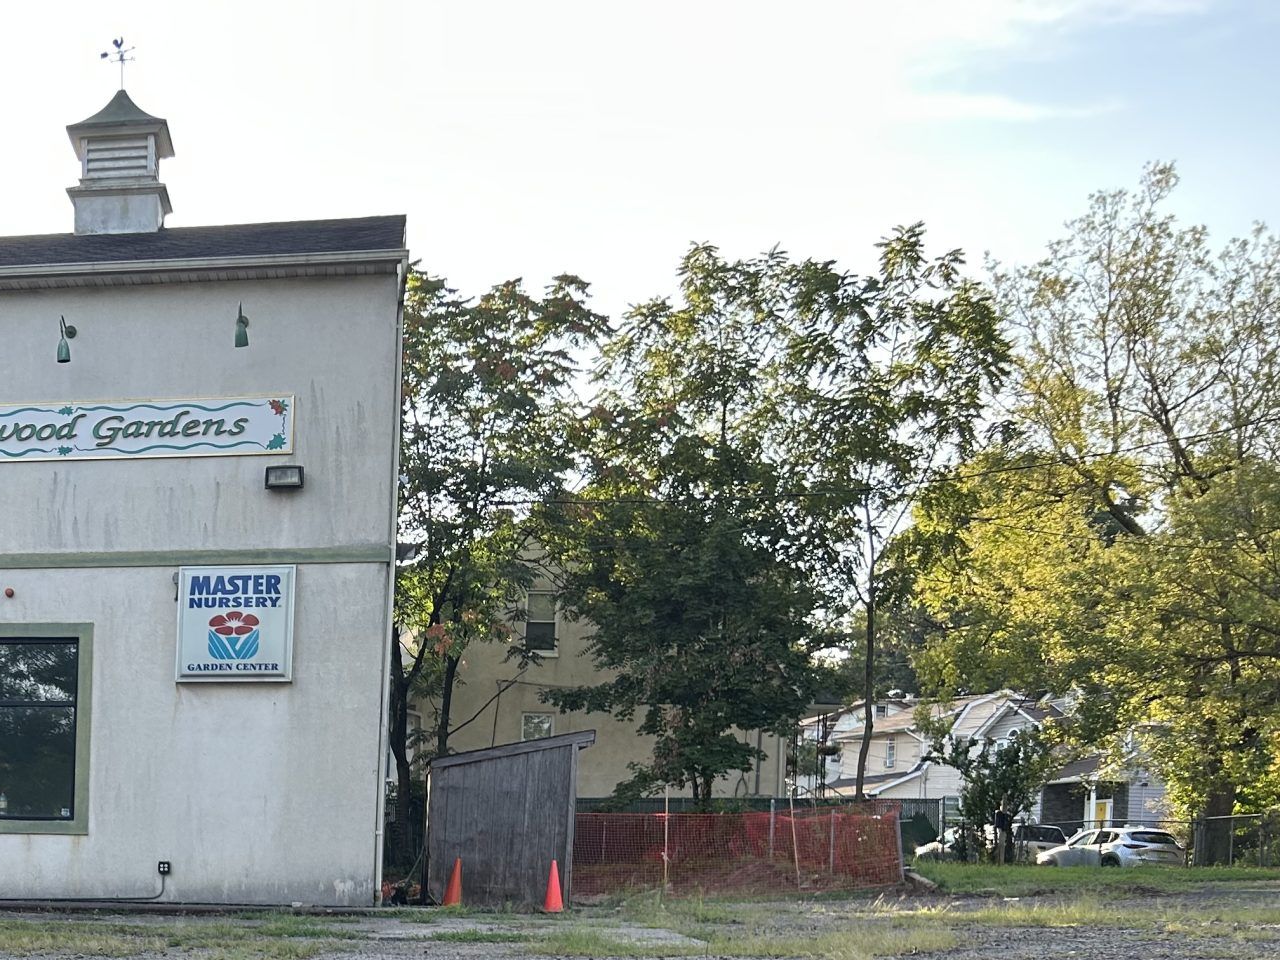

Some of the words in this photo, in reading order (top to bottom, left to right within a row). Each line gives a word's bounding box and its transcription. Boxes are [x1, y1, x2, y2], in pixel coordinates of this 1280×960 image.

[91, 410, 250, 447] Gardens
[190, 575, 281, 595] MASTER
[189, 596, 281, 609] NURSERY
[187, 663, 233, 671] GARDEN
[235, 662, 279, 671] CENTER
